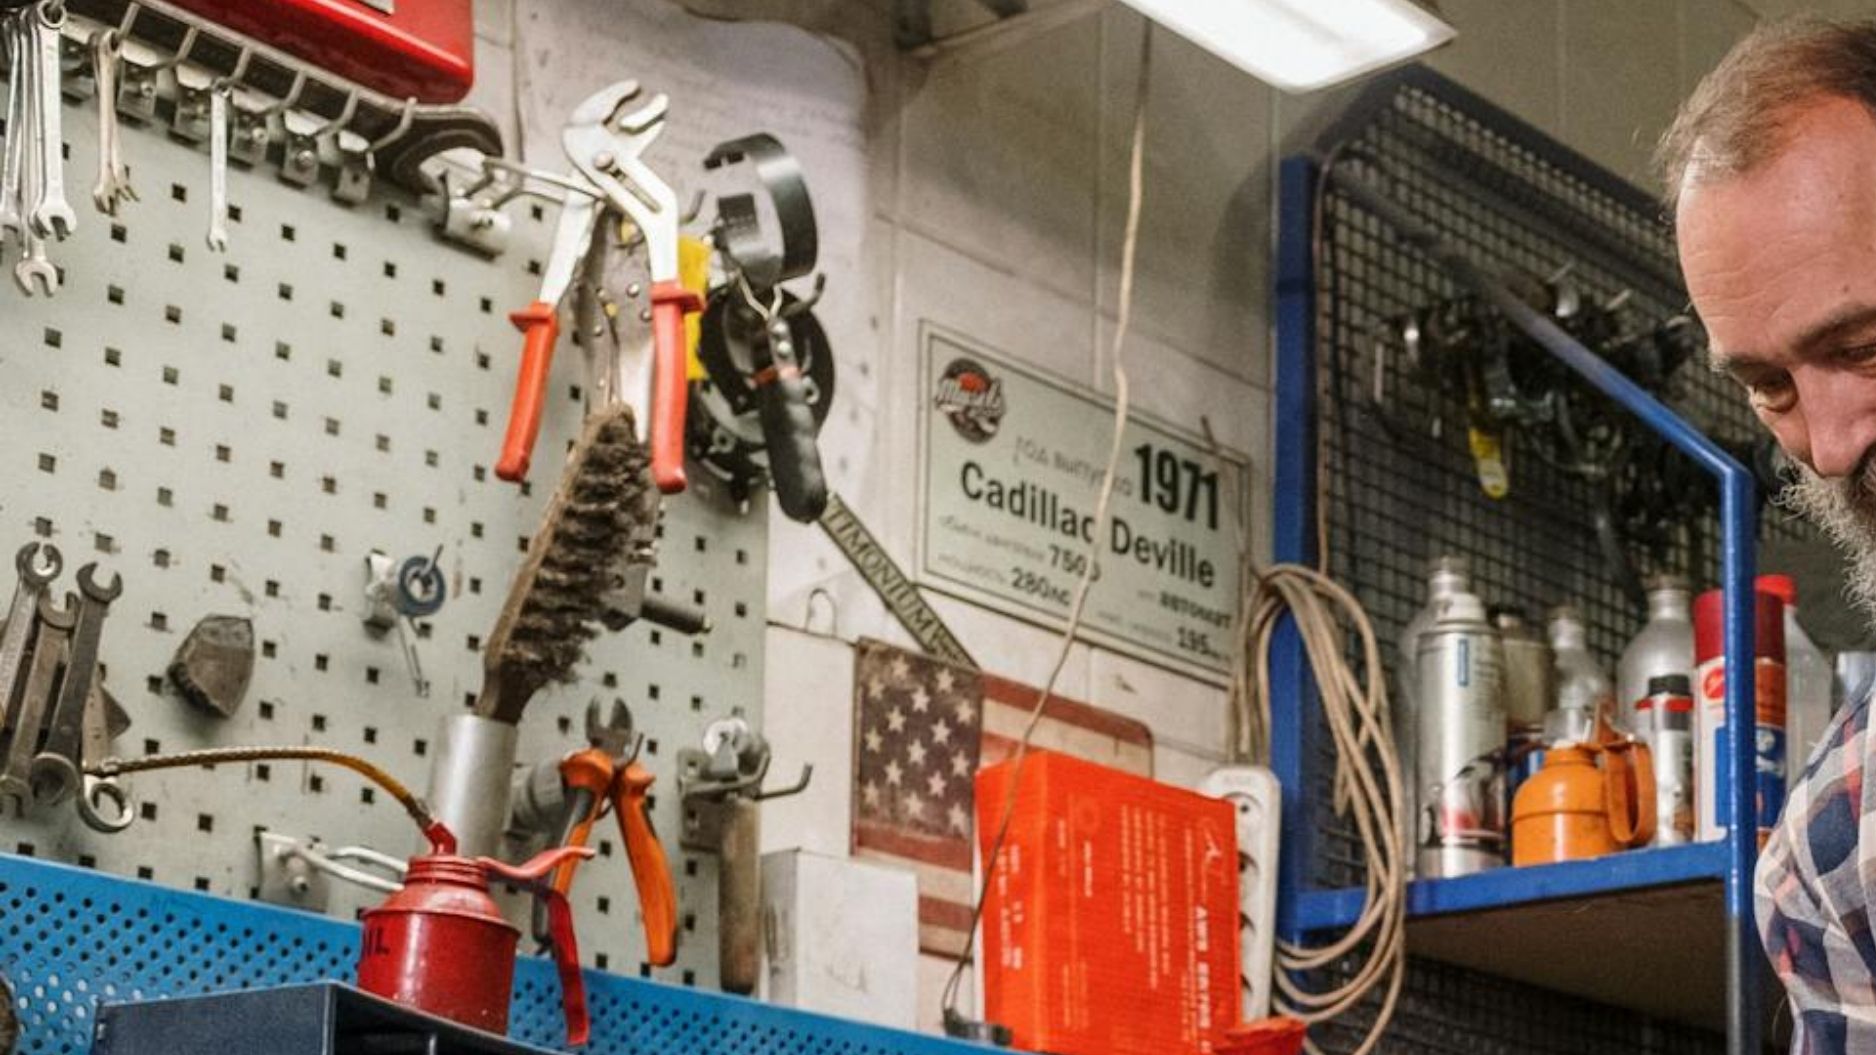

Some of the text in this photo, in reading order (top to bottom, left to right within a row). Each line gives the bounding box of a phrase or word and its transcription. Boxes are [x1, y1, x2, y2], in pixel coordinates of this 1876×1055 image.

[960, 461, 1095, 545] Cadillac
[1110, 516, 1216, 589] Deville
[1135, 444, 1219, 531] 1971
[827, 507, 933, 637] TIMONIUM
